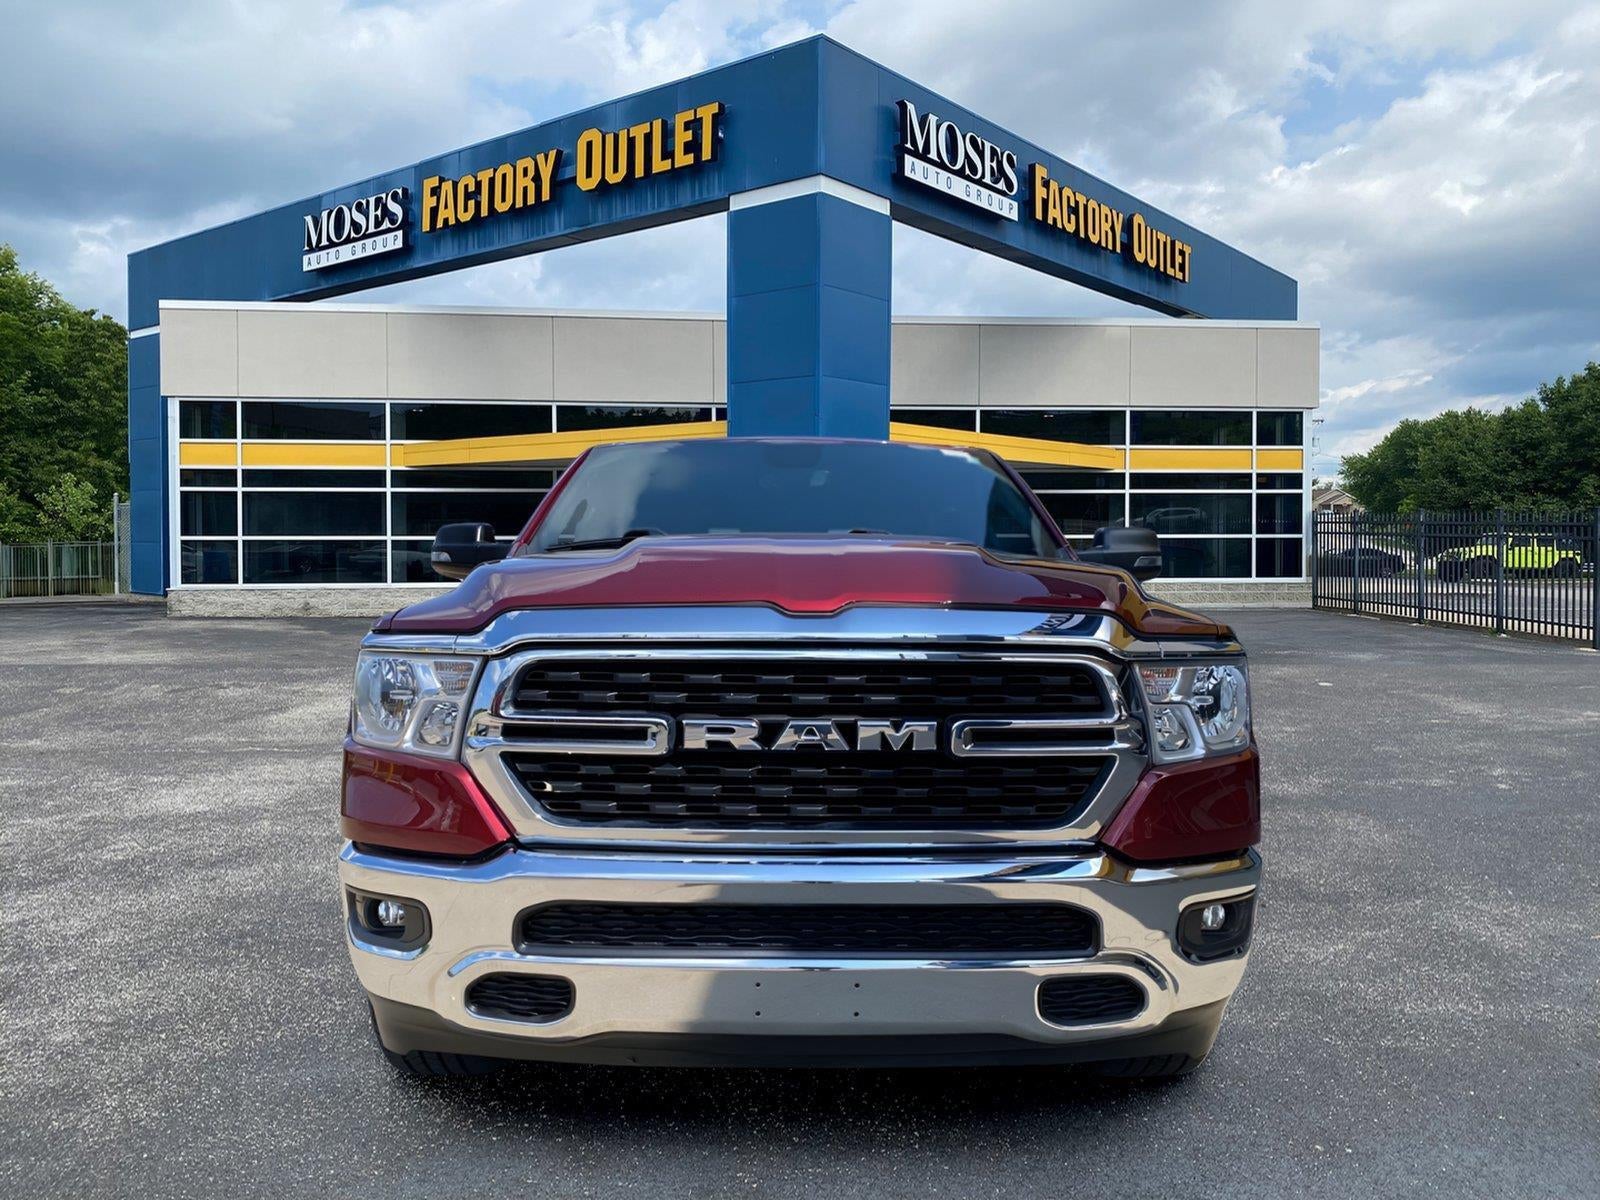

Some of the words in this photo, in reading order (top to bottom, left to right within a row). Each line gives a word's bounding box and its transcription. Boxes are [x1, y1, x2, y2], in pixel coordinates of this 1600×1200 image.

[422, 149, 559, 233] FACTORY
[577, 101, 720, 192] OUTLET
[904, 100, 1018, 196] MOSES
[303, 188, 403, 251] MOSES
[910, 161, 953, 190] AUTO
[965, 183, 1014, 215] GROUP
[307, 249, 340, 268] AUTO
[351, 234, 399, 256] GROUP
[1034, 162, 1124, 254] FACTORY
[1131, 212, 1192, 283] OUTLET
[682, 718, 938, 751] RAM
